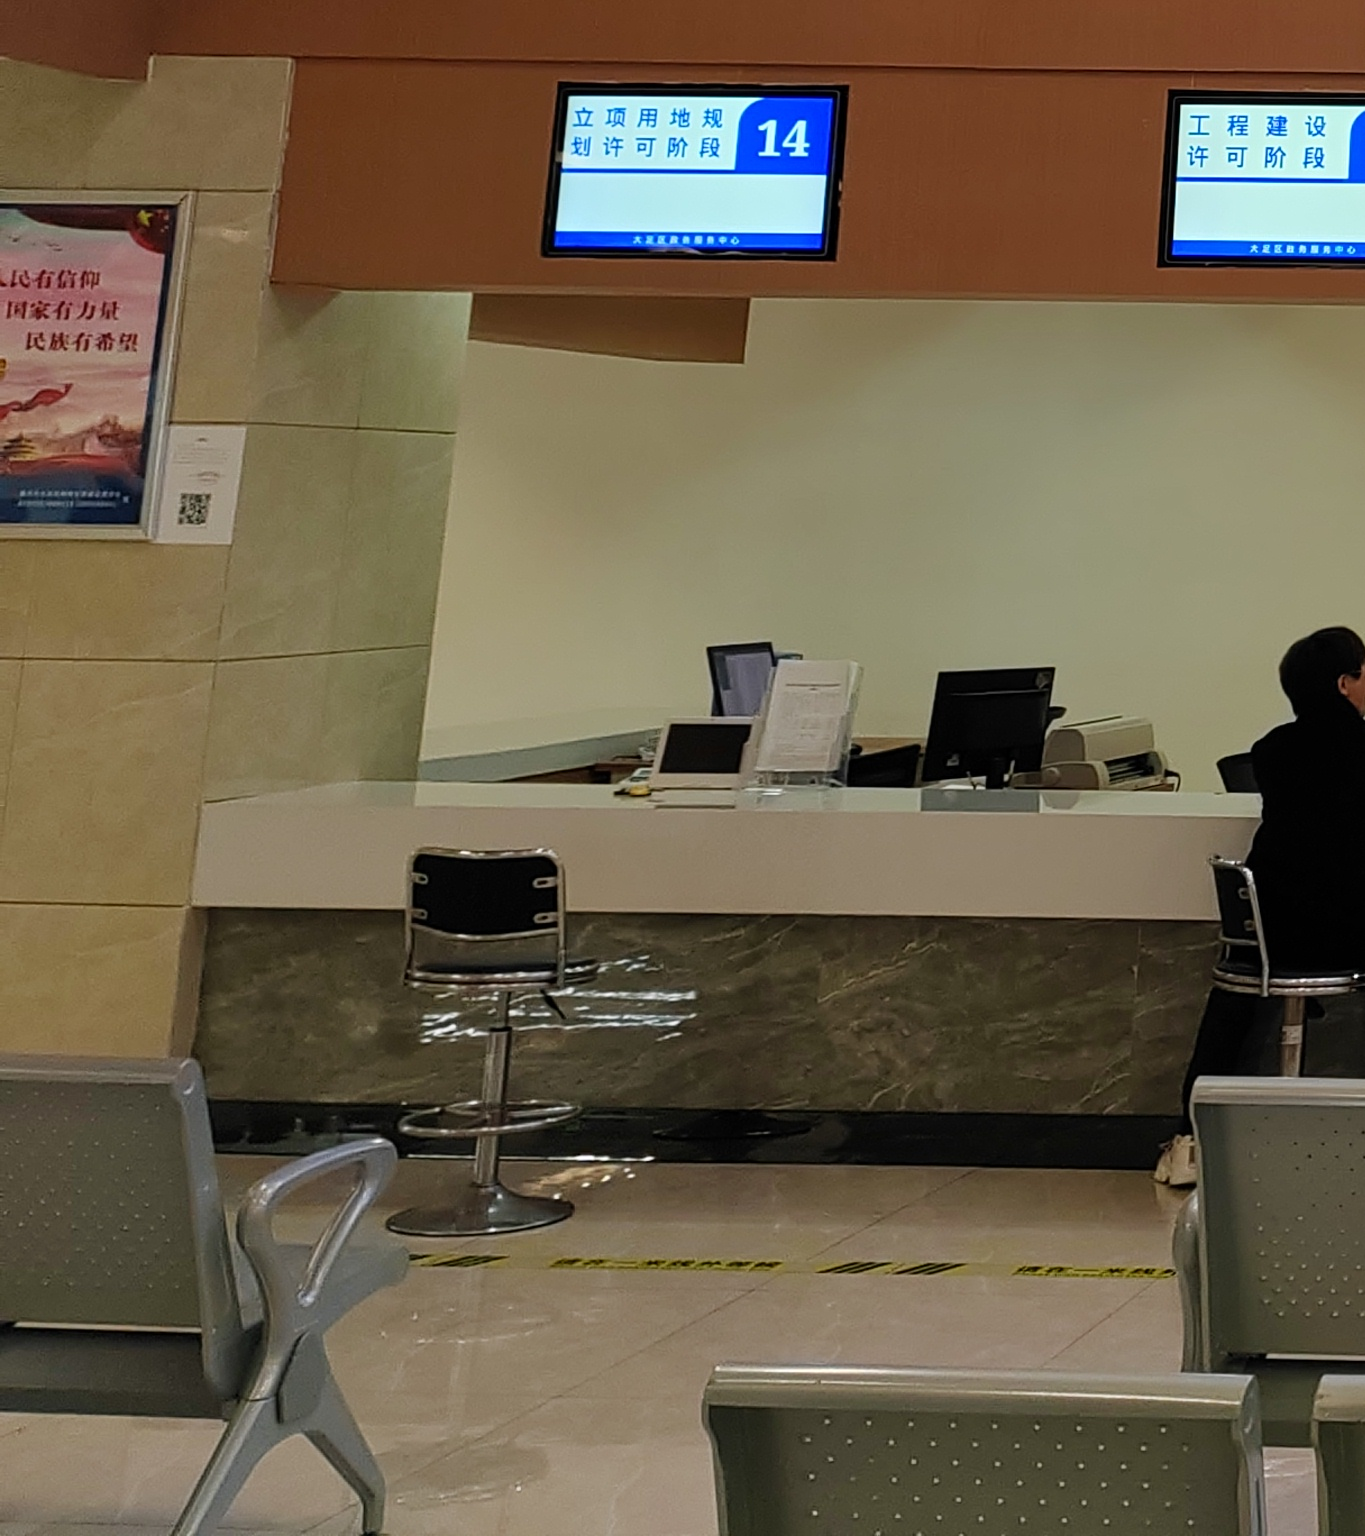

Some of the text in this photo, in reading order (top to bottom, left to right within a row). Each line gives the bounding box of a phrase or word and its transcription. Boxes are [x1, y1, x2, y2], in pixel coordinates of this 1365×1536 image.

[572, 107, 723, 128] 立项用地规
[1188, 115, 1327, 138] 工程建设
[570, 137, 721, 158] 划许可阶段
[757, 119, 811, 157] 14
[1186, 145, 1326, 169] 许可阶段
[1249, 244, 1356, 255] 大足区政务服务中心
[6, 300, 120, 321] 国家有力量
[25, 331, 139, 353] 民族有希望
